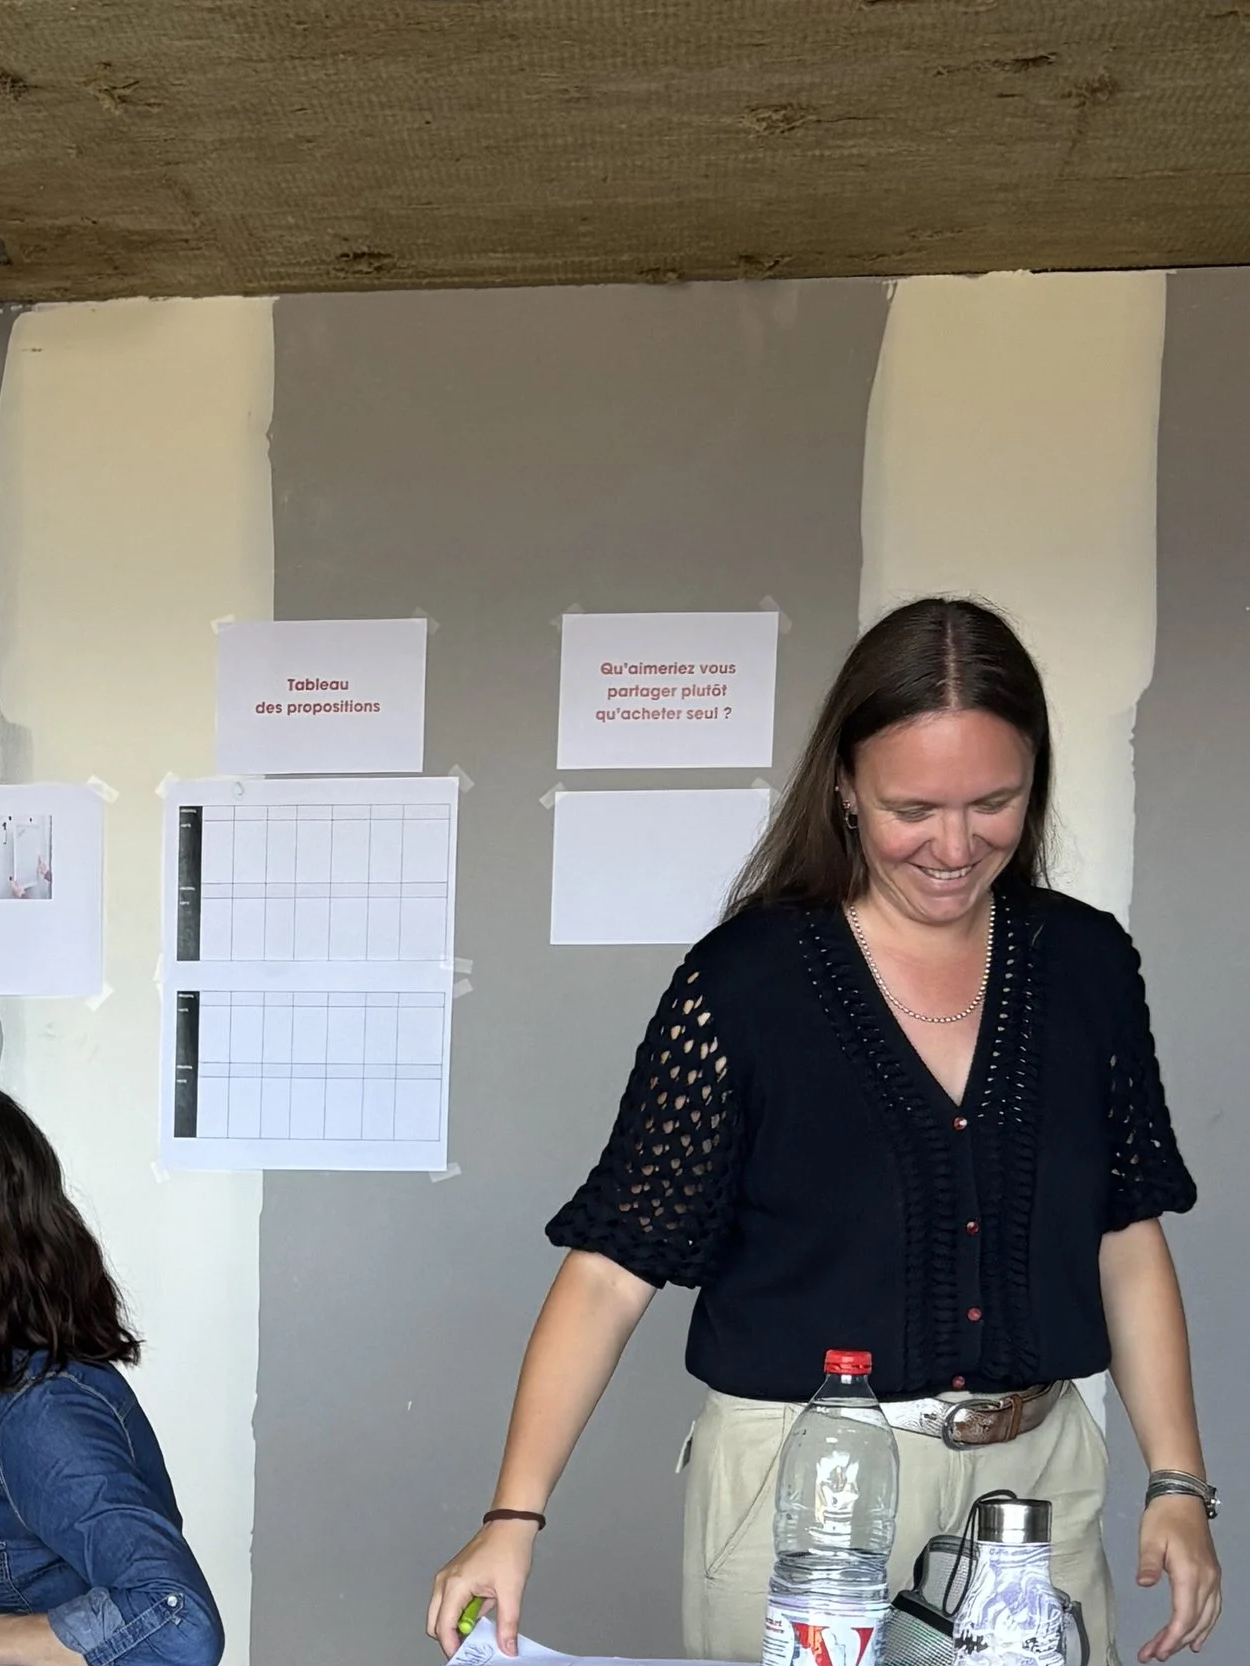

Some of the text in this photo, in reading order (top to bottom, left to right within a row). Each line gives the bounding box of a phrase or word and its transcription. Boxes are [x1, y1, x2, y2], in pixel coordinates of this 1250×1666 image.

[600, 661, 737, 676] Qu'aimeriez vous
[286, 677, 350, 692] Tableau
[607, 683, 728, 701] partager plutôt
[254, 699, 381, 717] des propositions
[595, 706, 733, 724] qu'acheter seul ?
